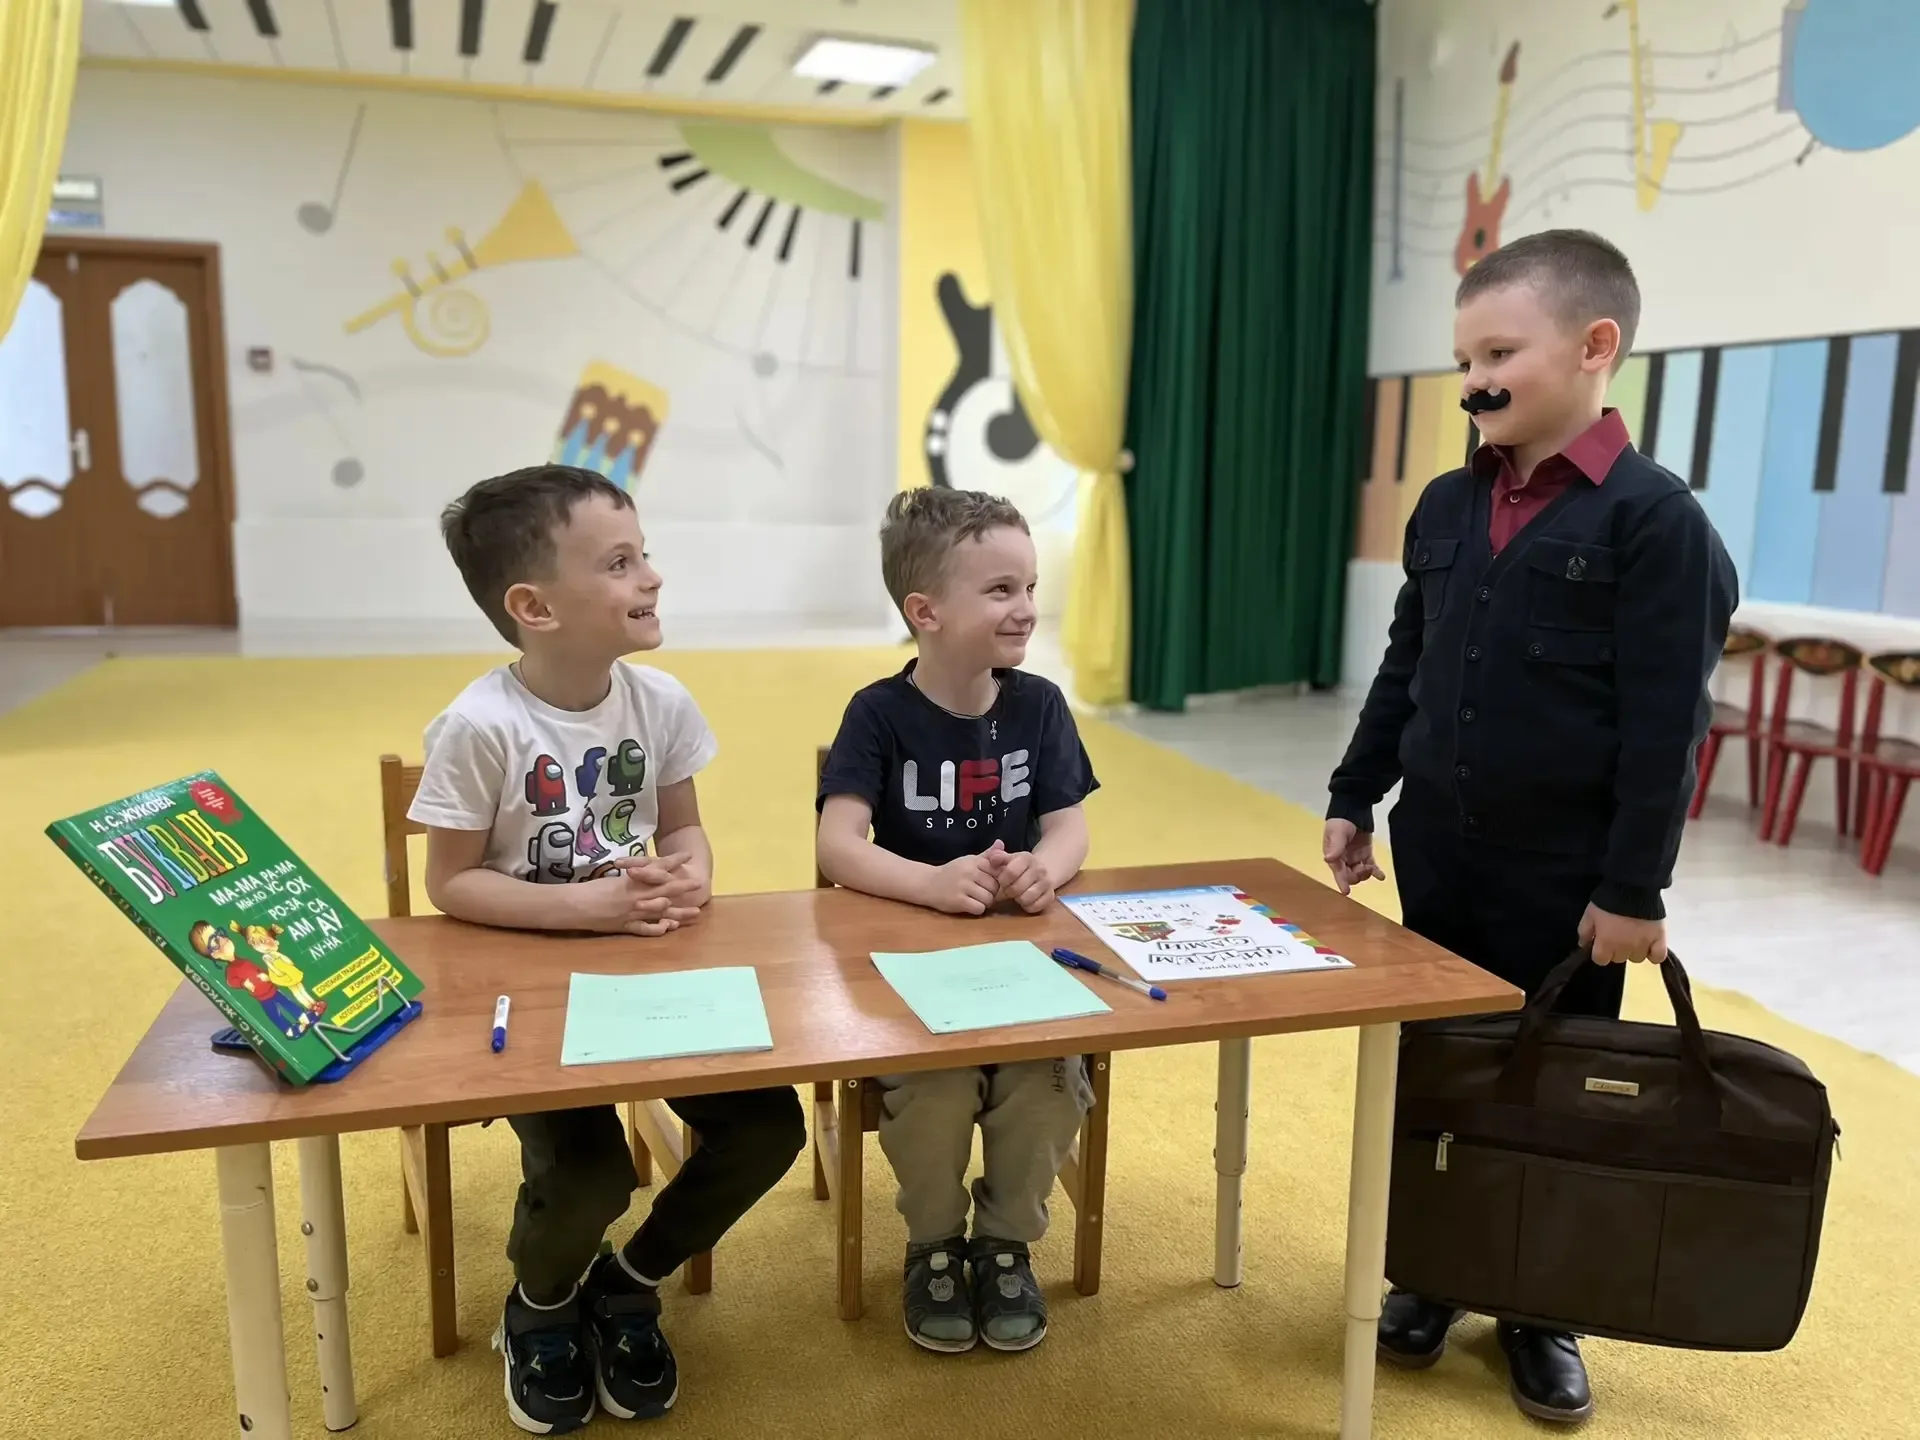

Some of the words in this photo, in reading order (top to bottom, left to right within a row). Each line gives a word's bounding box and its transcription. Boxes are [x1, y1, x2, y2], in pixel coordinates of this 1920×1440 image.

[903, 749, 1031, 812] LIFE
[120, 795, 177, 824] ЖУКОВА
[926, 807, 1008, 829] SPORT
[96, 809, 249, 905] БУКВАРЬ
[208, 874, 262, 906] МА-МА
[259, 860, 297, 882] РА-МА
[235, 890, 268, 912] МЫ-ЛО
[263, 880, 284, 895] УС
[285, 875, 312, 895] ОХ
[267, 897, 305, 920] РО-ЗА
[307, 898, 329, 914] СА
[287, 917, 315, 942] АМ
[316, 908, 344, 937] АУ
[309, 935, 343, 961] ЛУ-НА
[1155, 948, 1282, 964] ЧИТАЕМ
[1164, 937, 1250, 950] САМИ
[184, 963, 237, 1019] ЖУКОВА
